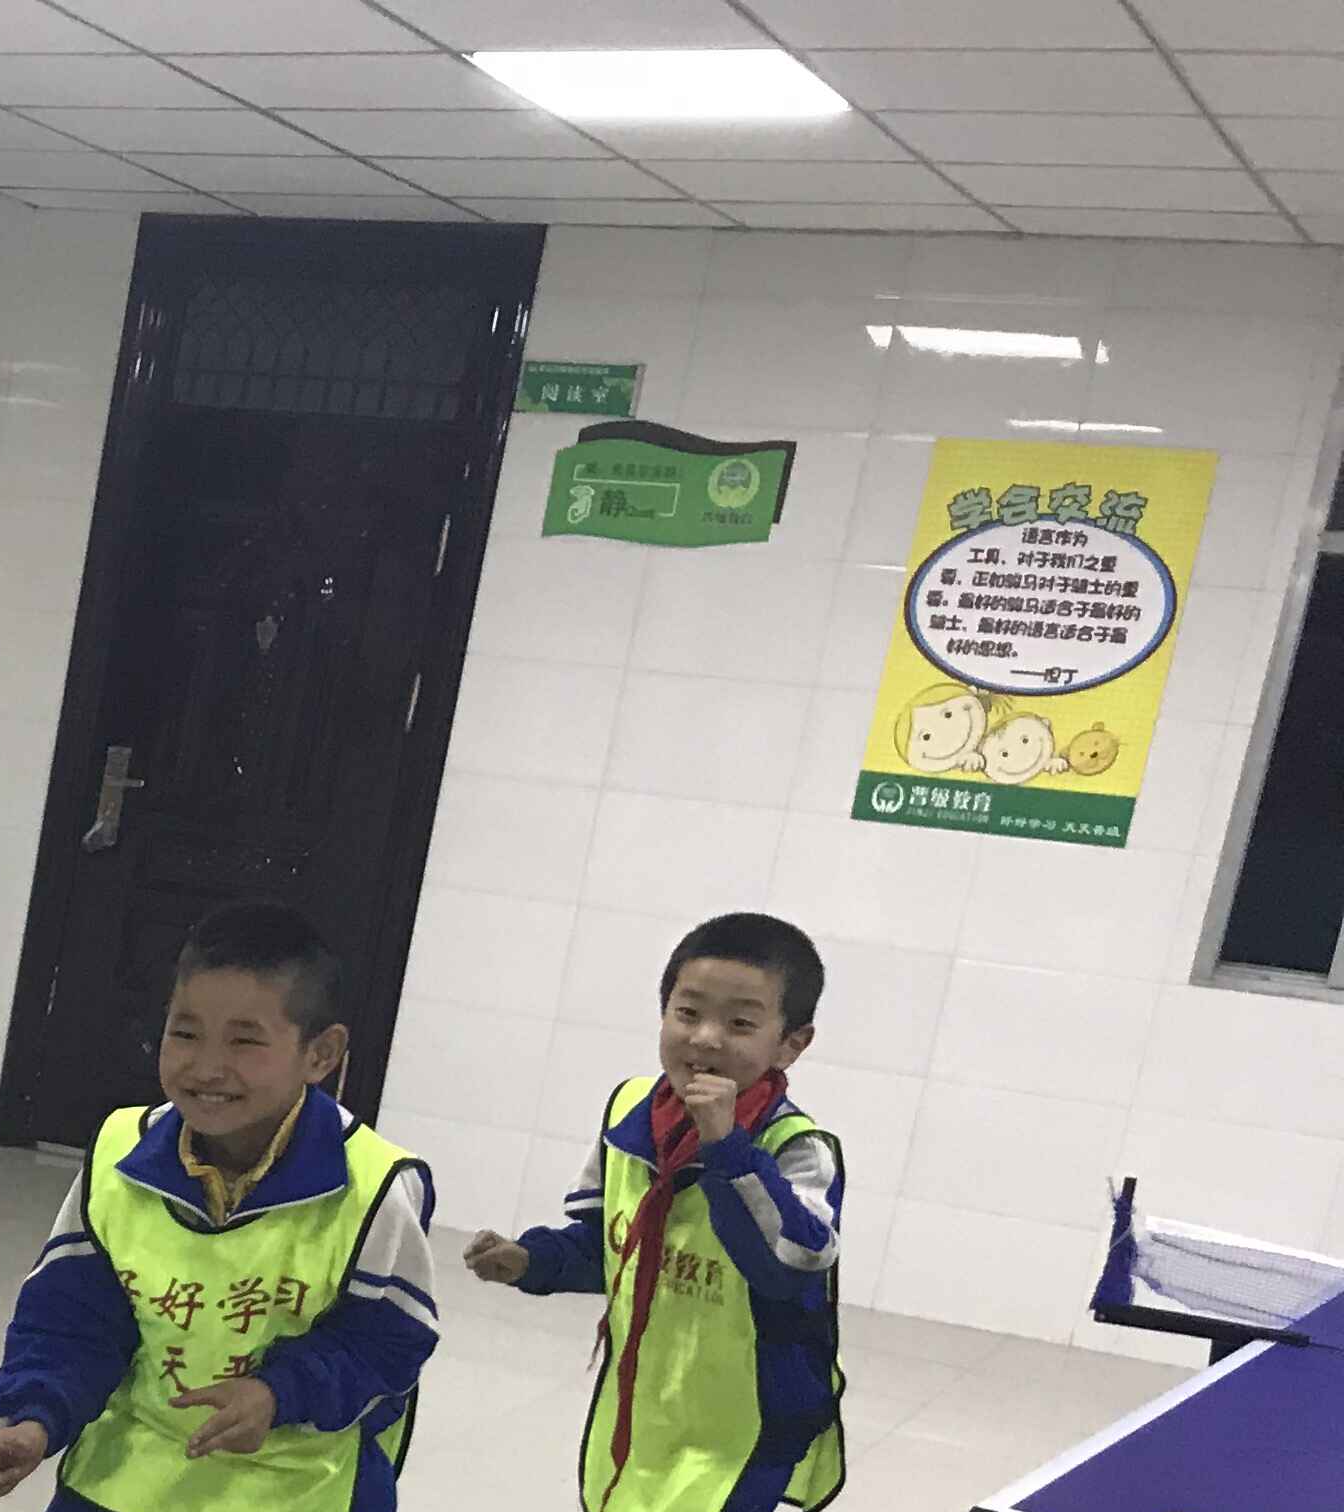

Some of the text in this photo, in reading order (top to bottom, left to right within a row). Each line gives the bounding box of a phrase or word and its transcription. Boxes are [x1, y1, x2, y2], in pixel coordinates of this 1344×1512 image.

[947, 482, 1149, 535] 学会交流
[1021, 527, 1088, 547] 语言作为
[909, 785, 992, 812] 晋级教育
